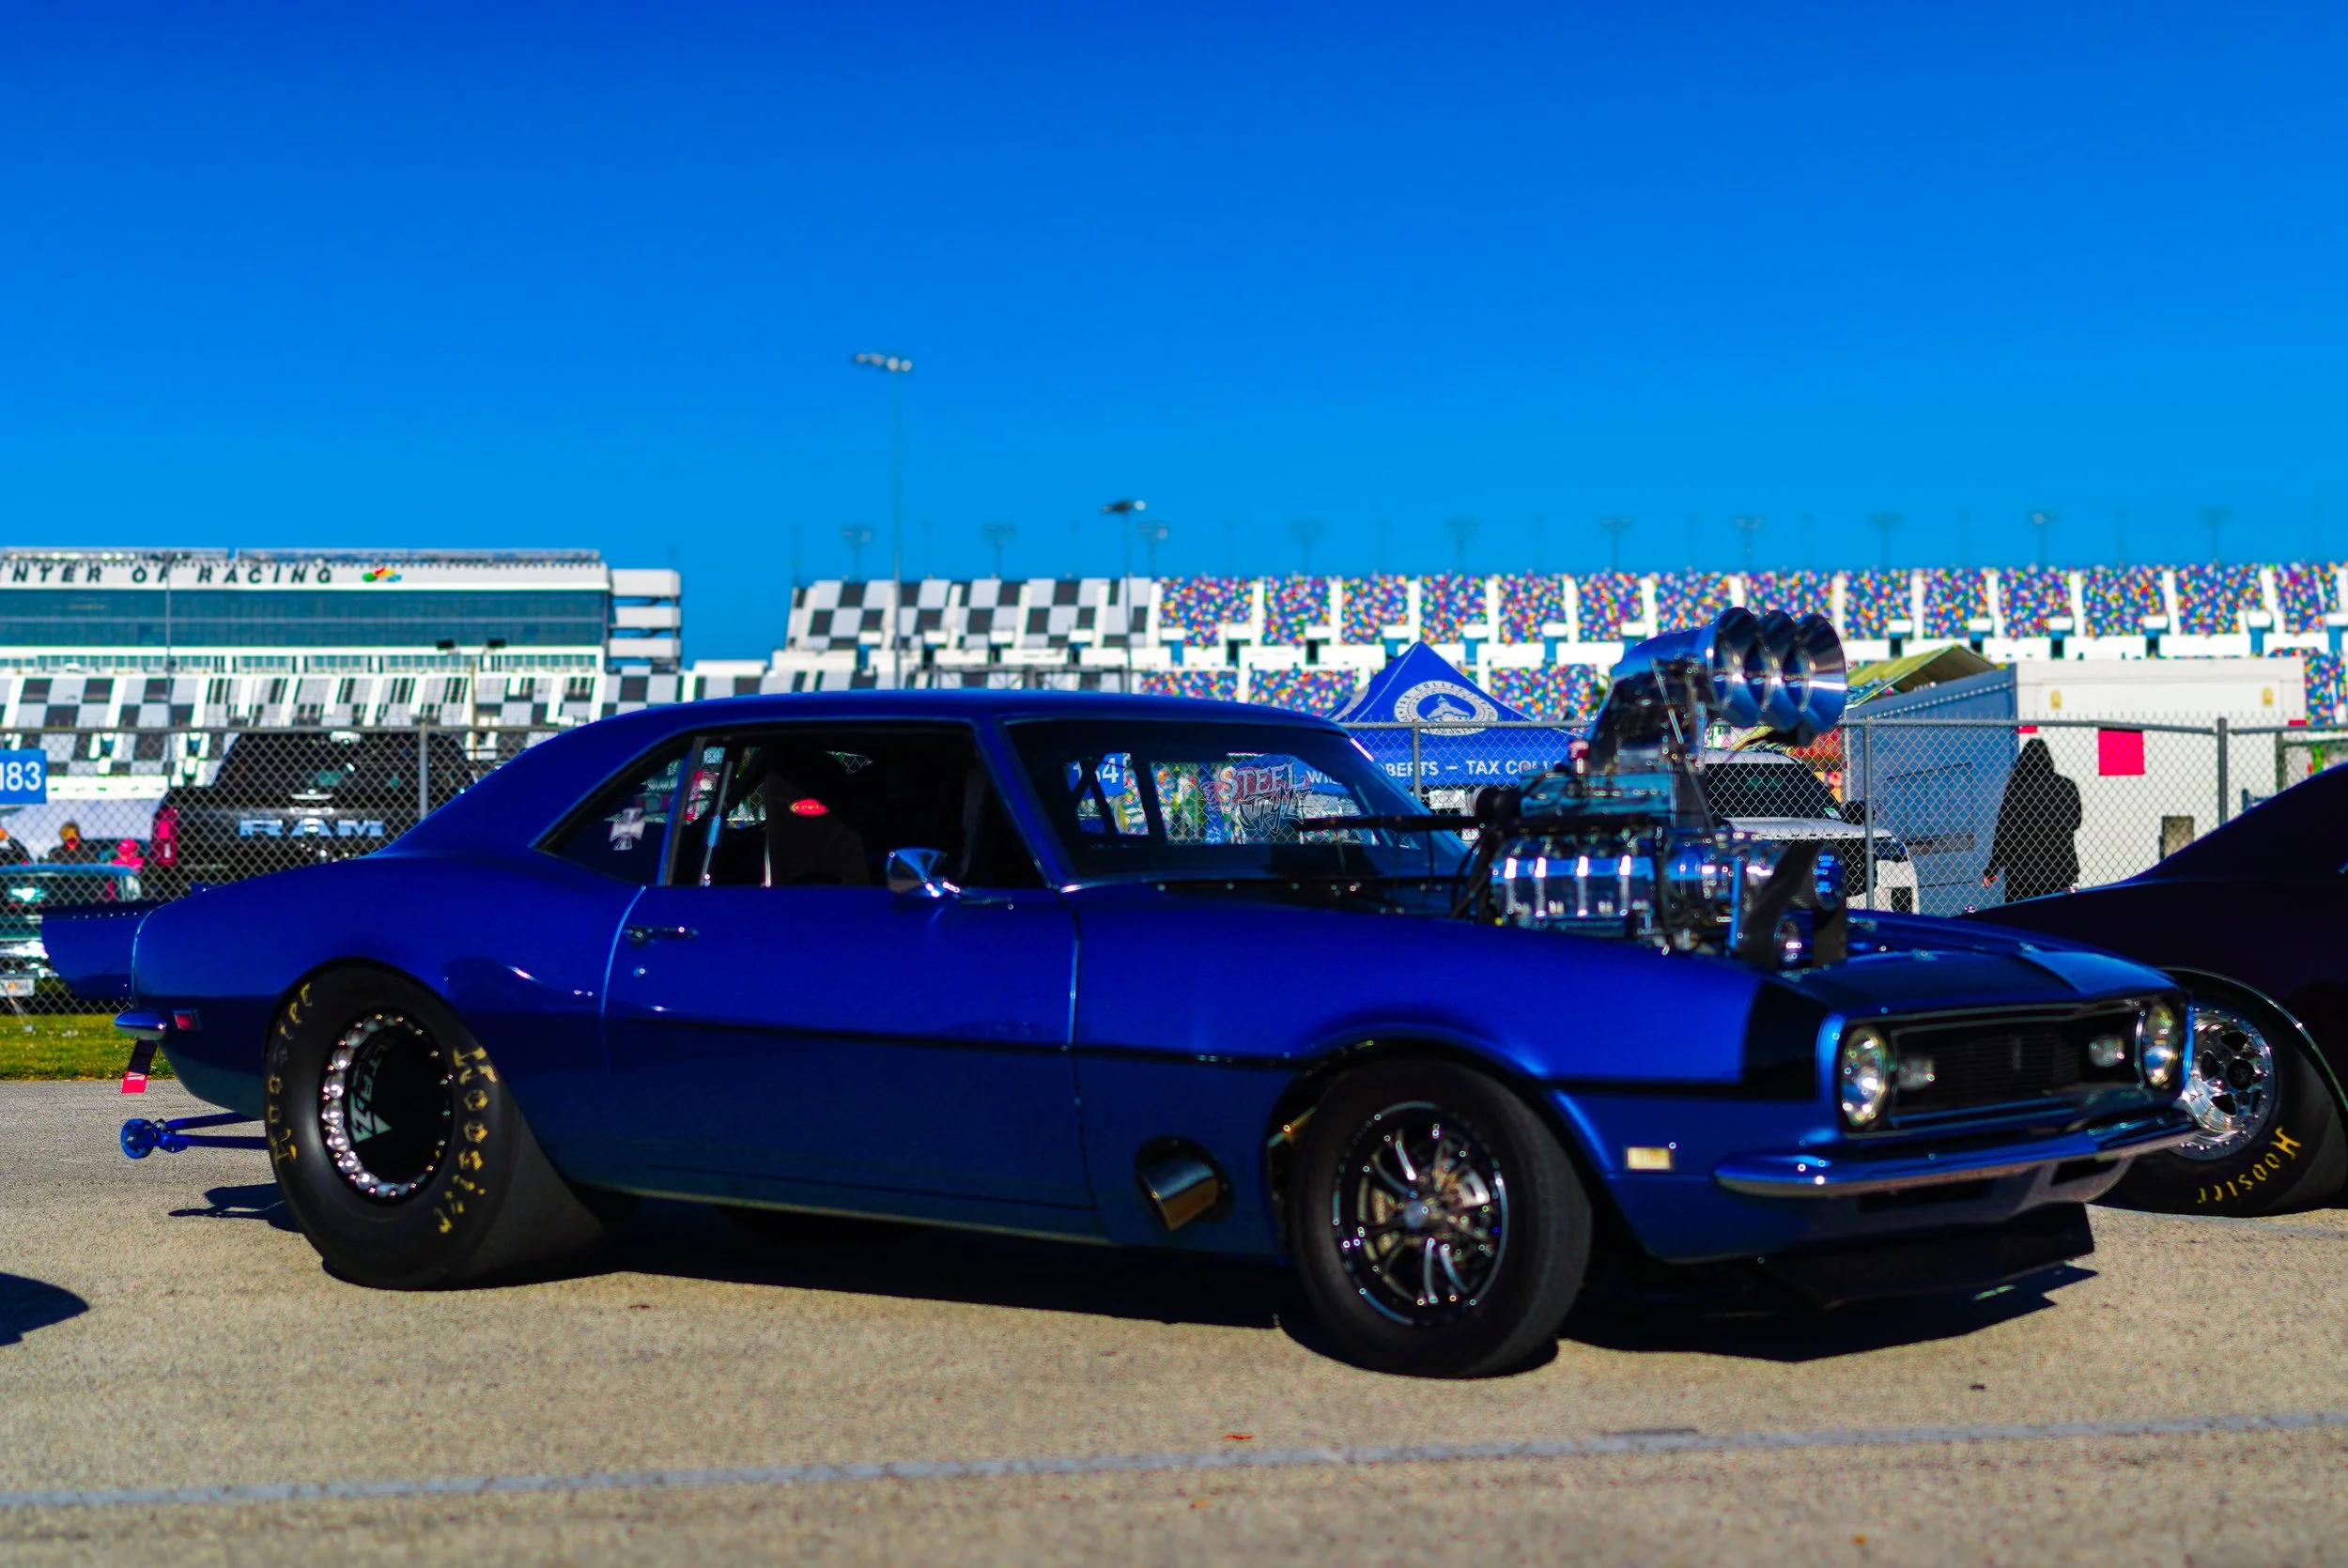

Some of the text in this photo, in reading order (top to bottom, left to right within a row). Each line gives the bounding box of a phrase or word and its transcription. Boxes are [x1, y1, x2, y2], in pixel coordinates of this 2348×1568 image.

[0, 563, 102, 583] NTER
[197, 563, 332, 584] RACING
[1073, 758, 1120, 783] 14
[1378, 761, 1440, 777] BERTS
[1466, 760, 1501, 776] TAX
[1218, 763, 1295, 804] STEEL
[239, 819, 384, 838] RAM
